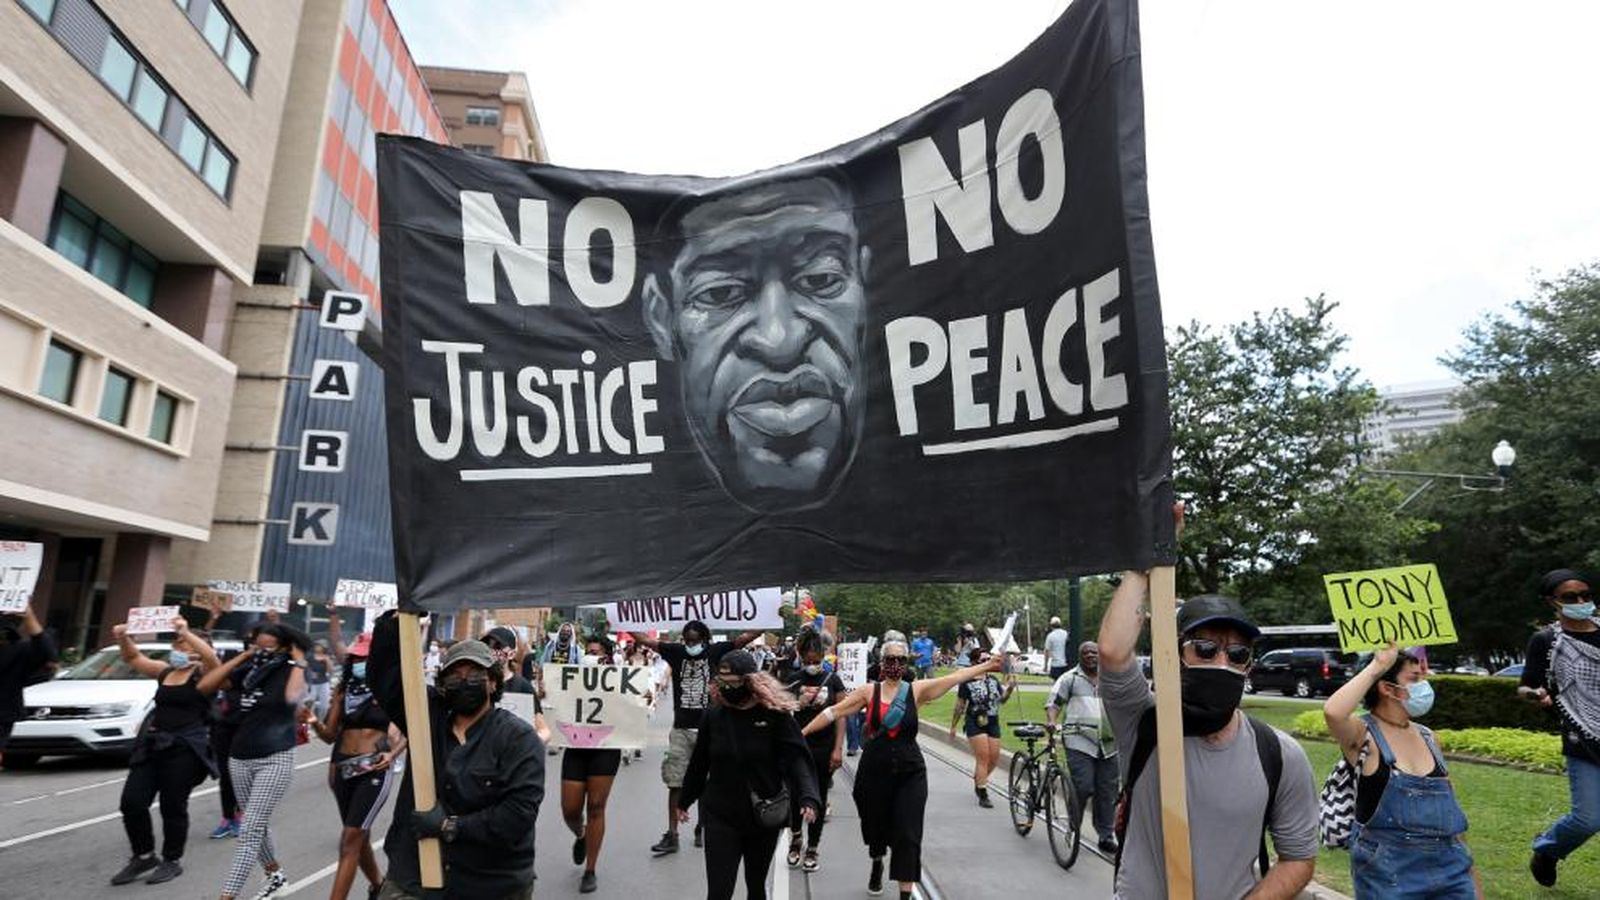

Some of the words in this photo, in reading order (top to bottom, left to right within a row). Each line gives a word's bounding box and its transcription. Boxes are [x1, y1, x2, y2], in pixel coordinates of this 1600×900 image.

[898, 88, 1066, 266] NO
[460, 190, 636, 308] NO
[885, 267, 1129, 436] PEACE
[291, 296, 363, 540] PARK
[337, 581, 375, 593] STOP
[617, 589, 757, 623] MINNEAPOLIS
[1330, 570, 1432, 609] TONY
[1338, 606, 1453, 648] MCDADE
[561, 666, 641, 695] FUCK
[575, 697, 604, 724] 12
